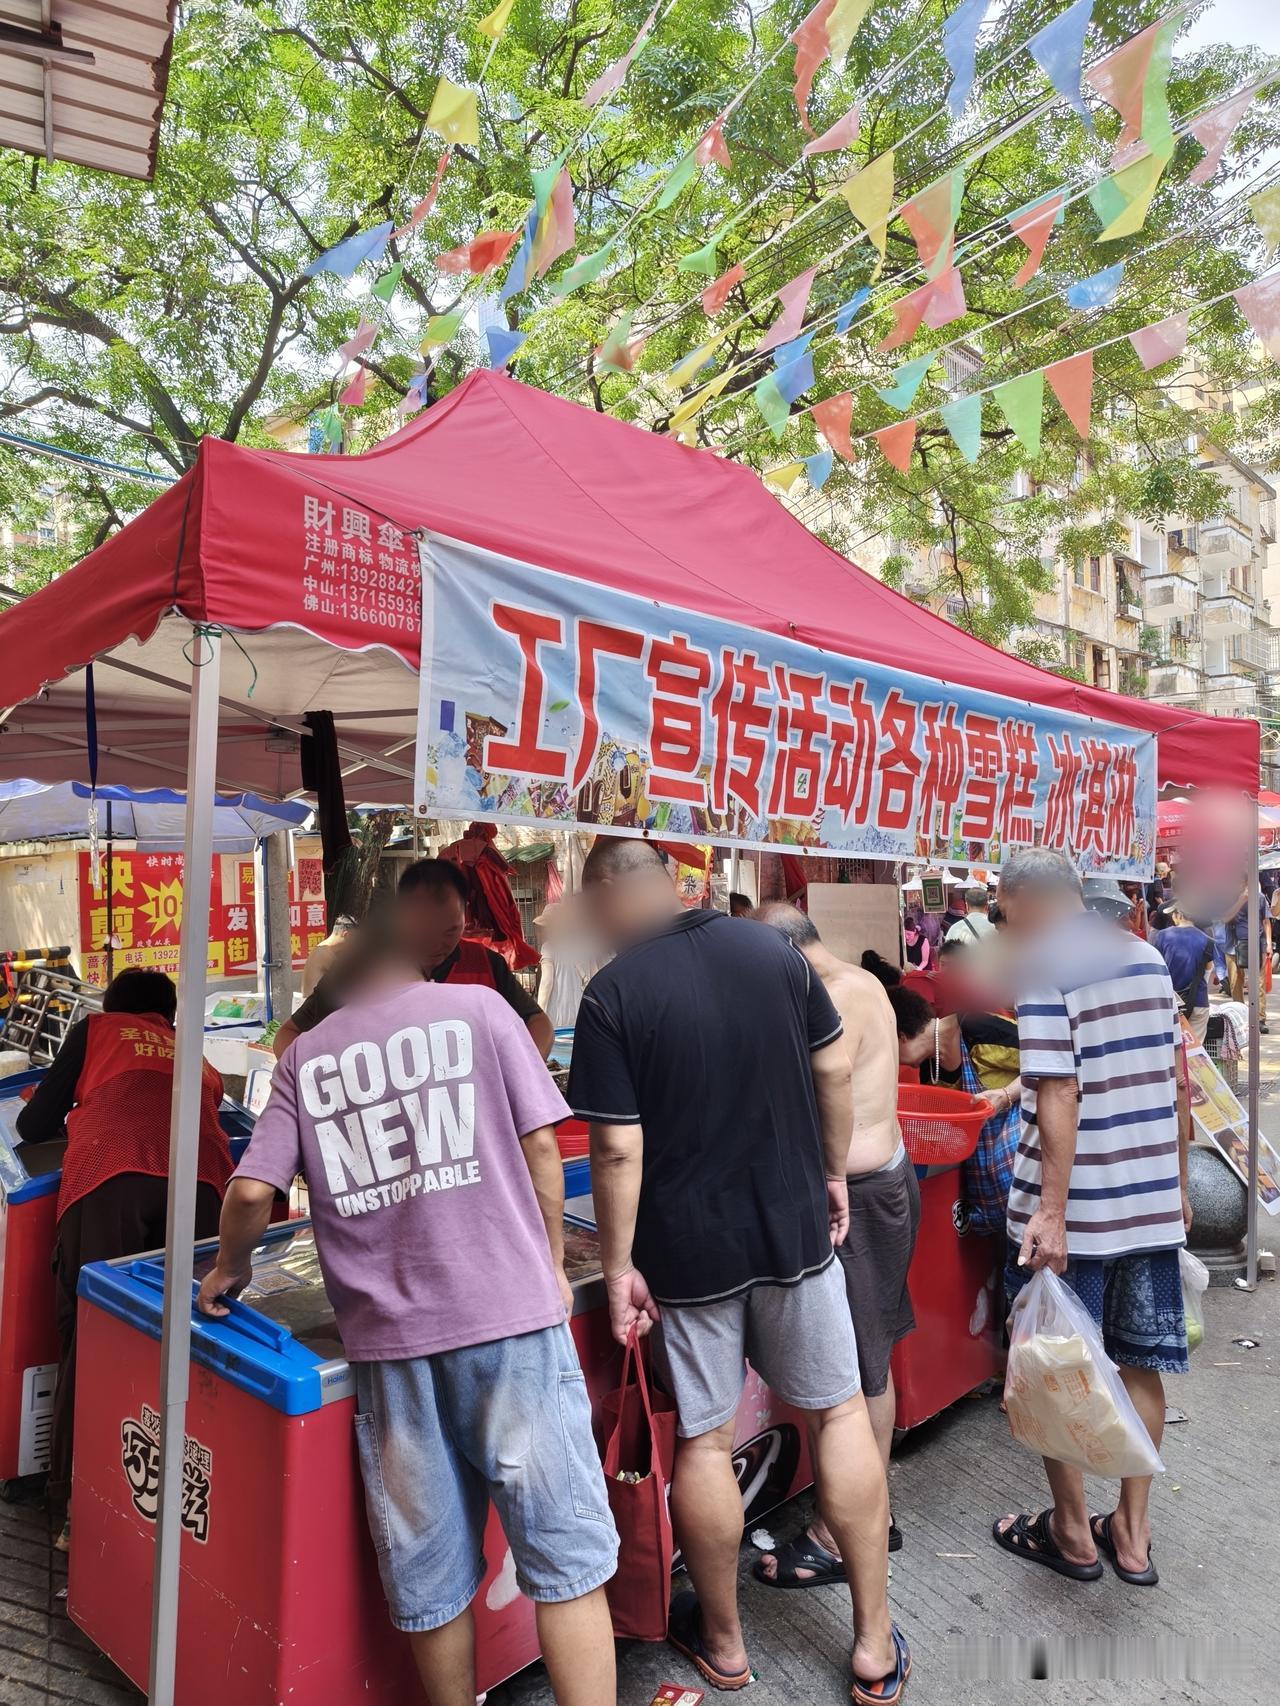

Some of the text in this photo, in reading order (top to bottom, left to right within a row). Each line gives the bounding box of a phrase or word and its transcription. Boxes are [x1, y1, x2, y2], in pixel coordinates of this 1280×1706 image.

[305, 533, 374, 566] 注册商标
[484, 600, 1139, 859] 工厂宣传活动各种雪糕 冰淇淋
[151, 895, 178, 918] 10
[299, 1019, 474, 1119] GOOD
[314, 1083, 475, 1195] NEW
[335, 1160, 482, 1218] UNSTOPPABLE
